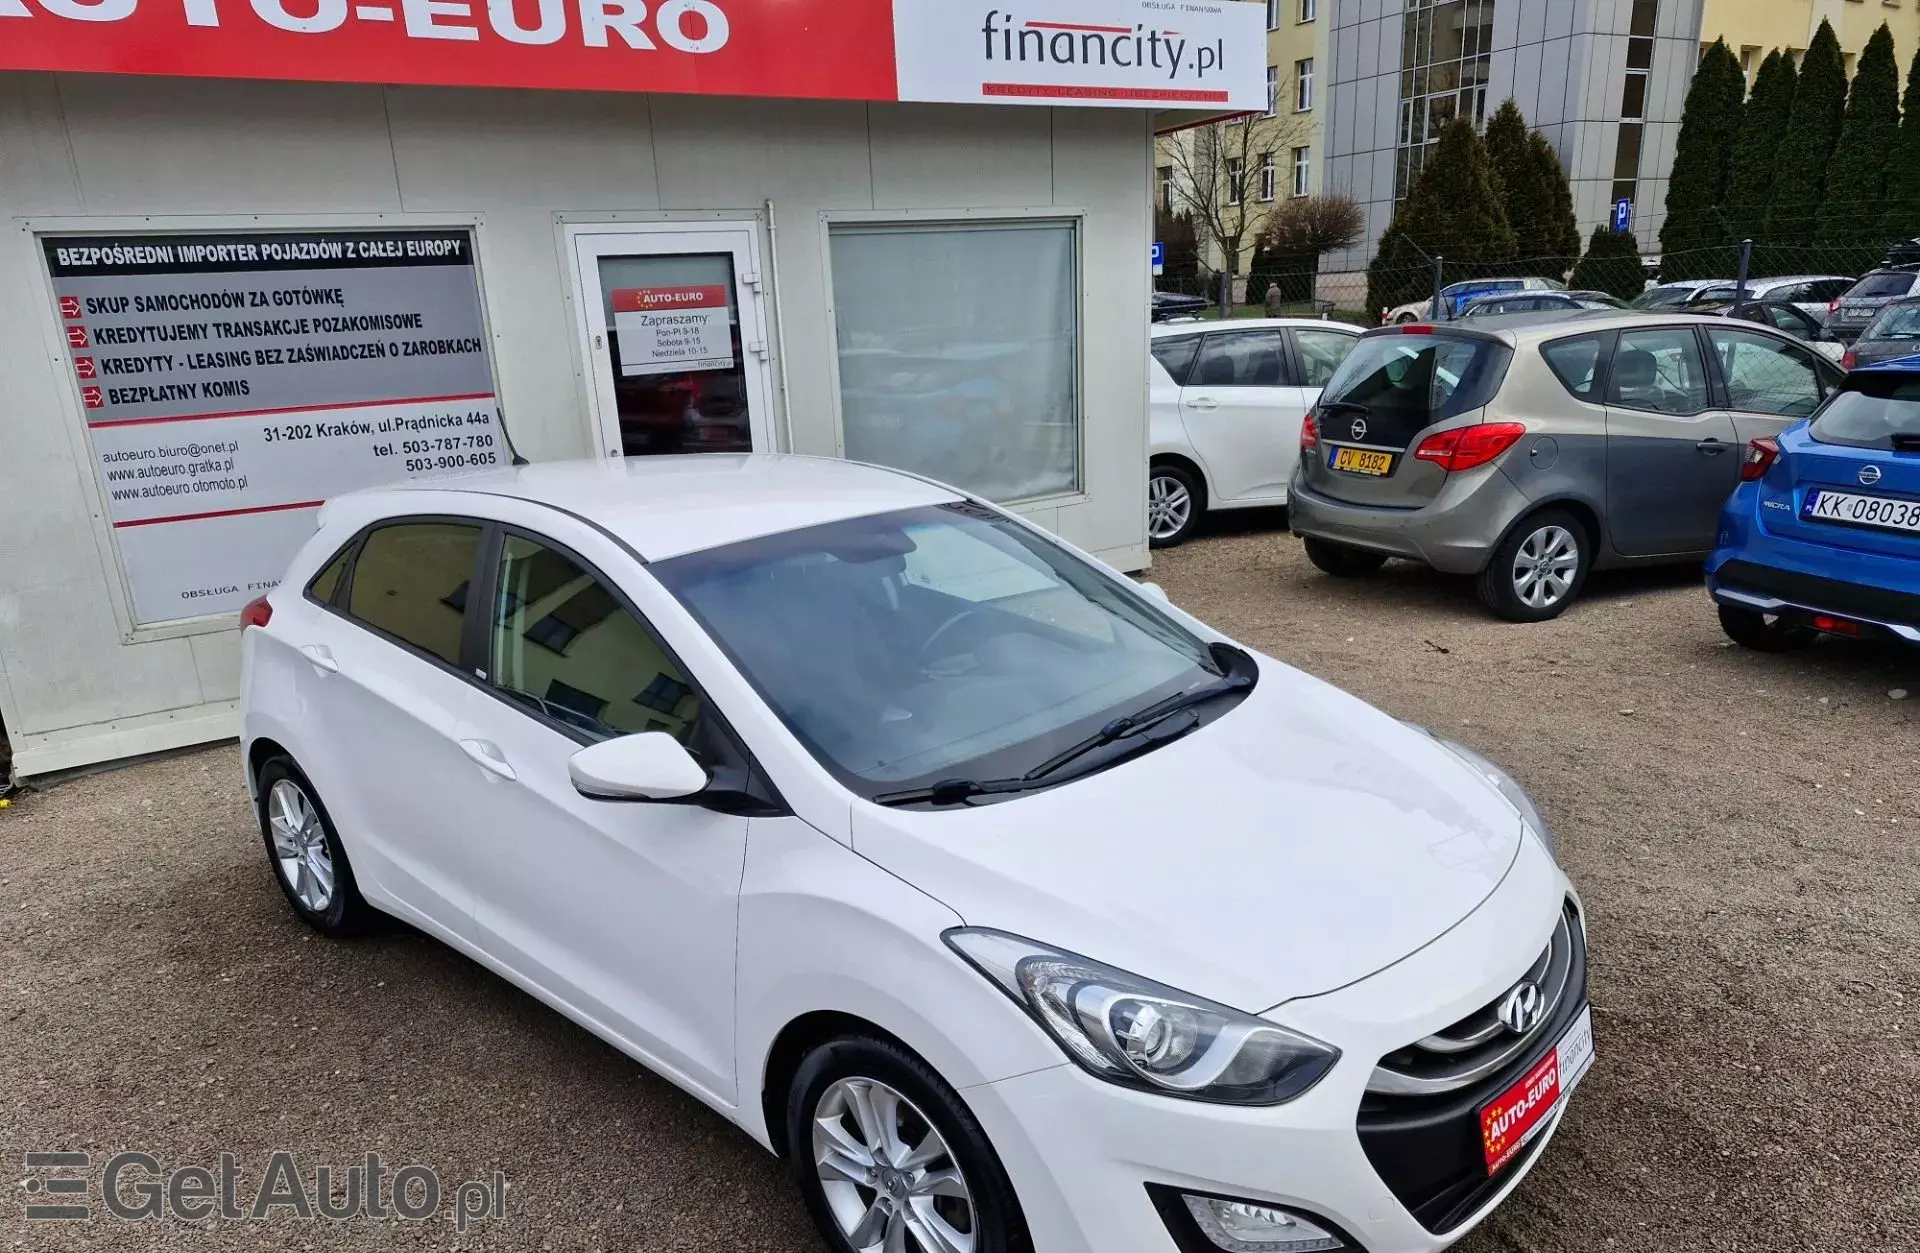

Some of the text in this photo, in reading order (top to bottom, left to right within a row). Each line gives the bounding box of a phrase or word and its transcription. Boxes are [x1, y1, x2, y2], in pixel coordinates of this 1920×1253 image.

[981, 10, 1223, 79] financity.pl
[57, 239, 460, 266] BEZPOŚREDNI IMPORTER POJAZDÓW Z CAŁEJ EUROPY
[85, 285, 345, 315] SKUP SAMOCHODÓW ZA GOTÓWKĘ
[643, 292, 704, 304] AUTO-EURO
[93, 313, 423, 345] KREDYTUJEMY TRANSAKCJE POZAKOMISOWE
[656, 327, 700, 337] Pon-Pt 9-18
[652, 346, 708, 358] Niedziela 10-15
[657, 337, 701, 348] Sobota 9-15
[101, 355, 174, 375] KREDYTY
[186, 350, 252, 370] LEASING
[255, 348, 284, 366] BEZ
[287, 339, 386, 364] ZAŚWIADCZEŃ
[389, 342, 398, 358] O
[402, 337, 482, 357] ZAROBKACH
[108, 379, 251, 405] BEZPŁATNY KOMIS
[263, 411, 490, 443] 31-202 Kraków, ul.Prądnicka 44a
[103, 440, 239, 463] autoeuro.biuro@onet.pl
[374, 434, 493, 457] tel. 503-787-780
[107, 457, 234, 482] www.autoeuro.gratka.pl
[406, 452, 497, 472] 503-900-605
[1340, 450, 1386, 470] CV 8182
[112, 475, 249, 501] www.autoeuro.otomoto.pl
[1763, 500, 1790, 511] MICRA
[1817, 494, 1920, 527] KK 08038
[181, 580, 282, 599] OBSŁUGA FINA
[1491, 1067, 1556, 1142] AUTO-EURO
